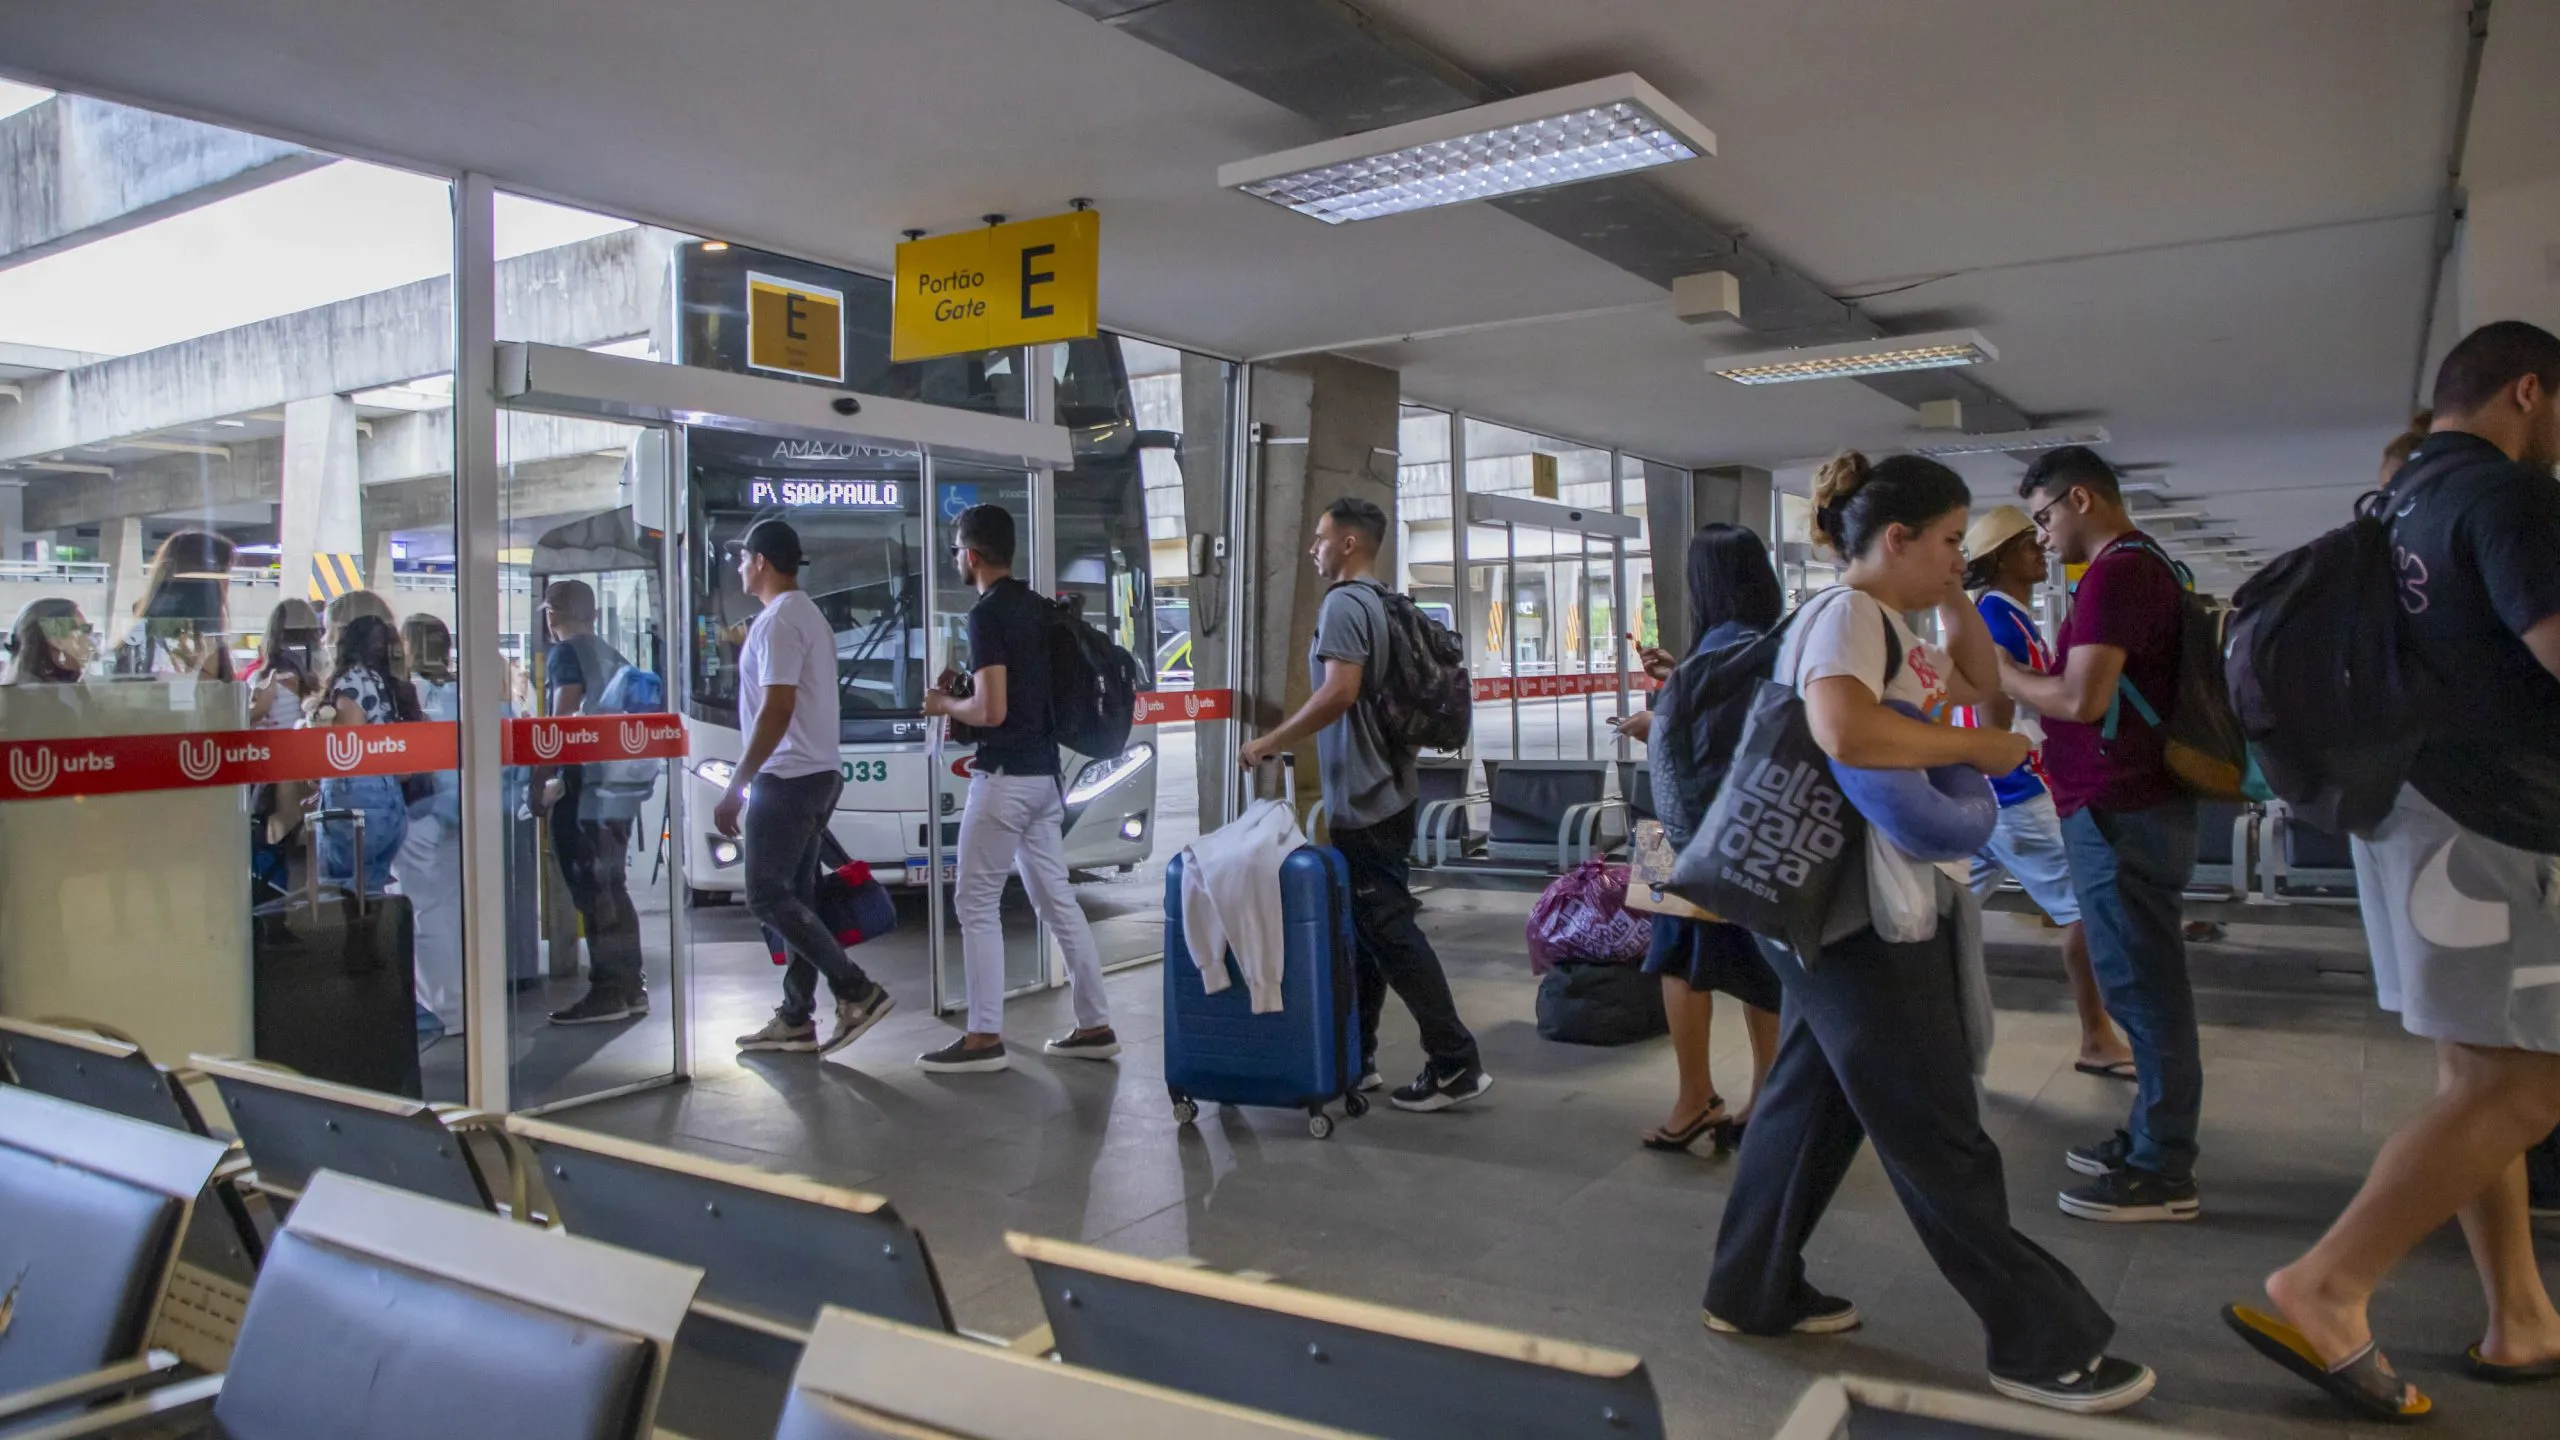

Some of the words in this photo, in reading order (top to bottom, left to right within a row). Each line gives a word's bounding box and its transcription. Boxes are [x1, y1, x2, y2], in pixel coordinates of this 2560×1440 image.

[919, 269, 985, 296] Portão
[1021, 243, 1055, 320] E
[787, 292, 807, 341] E
[935, 297, 986, 322] Gate
[829, 479, 898, 505] PAULO
[367, 736, 407, 754] urbs
[566, 728, 599, 744] urbs
[651, 725, 682, 740] urbs
[63, 752, 115, 772] urbs
[225, 744, 271, 762] urbs
[1721, 865, 1779, 904] BRASIL
